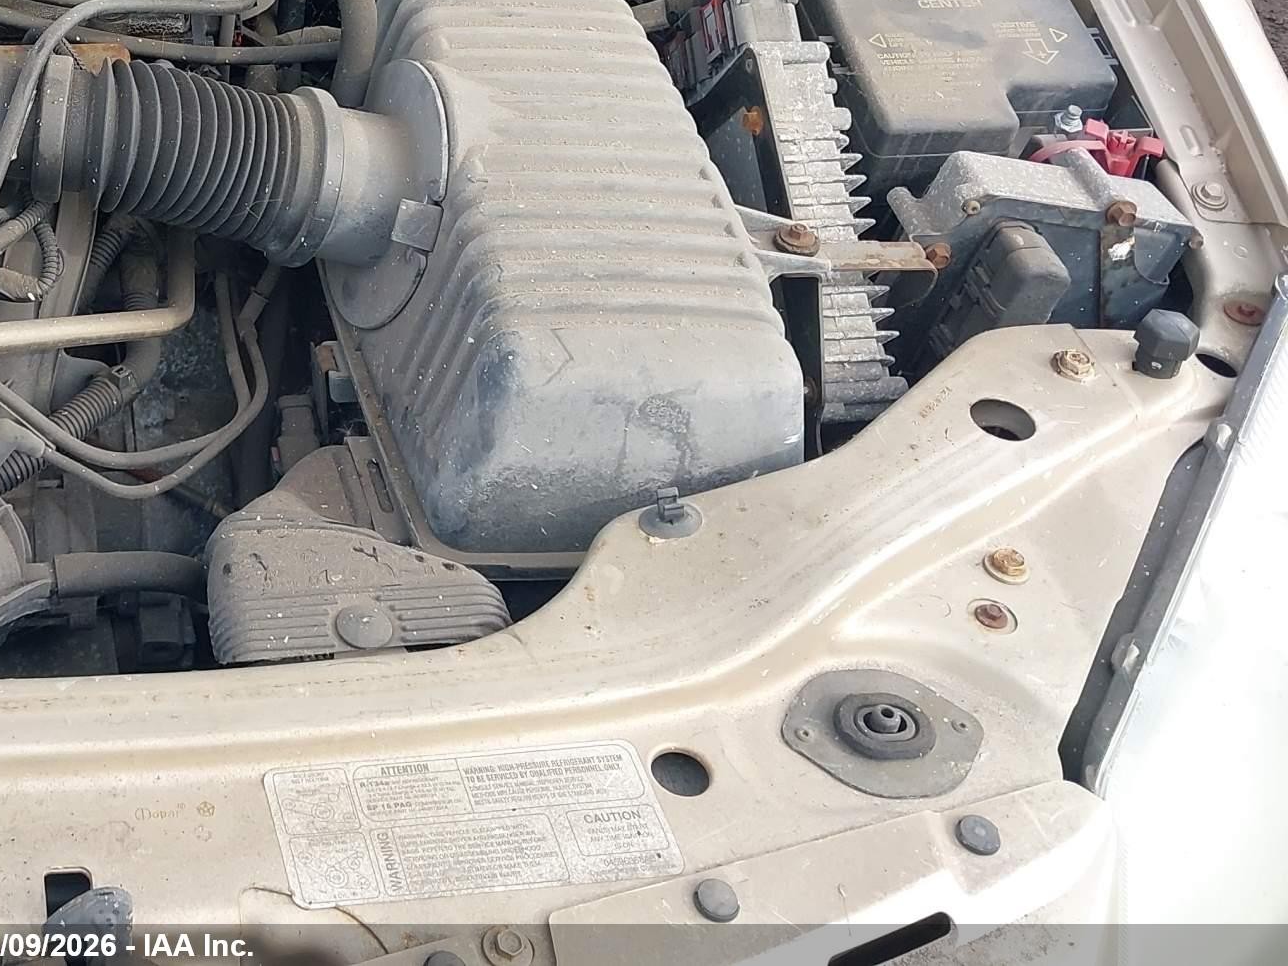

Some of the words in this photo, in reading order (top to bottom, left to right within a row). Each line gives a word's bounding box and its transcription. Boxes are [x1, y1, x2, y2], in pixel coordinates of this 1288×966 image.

[380, 762, 430, 776] ATTENTION
[497, 761, 551, 772] HIGH-PRESSURE
[551, 756, 596, 768] REFRIGERANT
[597, 753, 623, 764] SYSTEM
[465, 775, 476, 784] TO
[485, 771, 519, 782] SERVICED
[529, 767, 564, 778] QUALIFIED
[564, 763, 604, 776] PERSONNEL
[583, 809, 642, 824] CAUTION
[376, 832, 403, 892] WARNING
